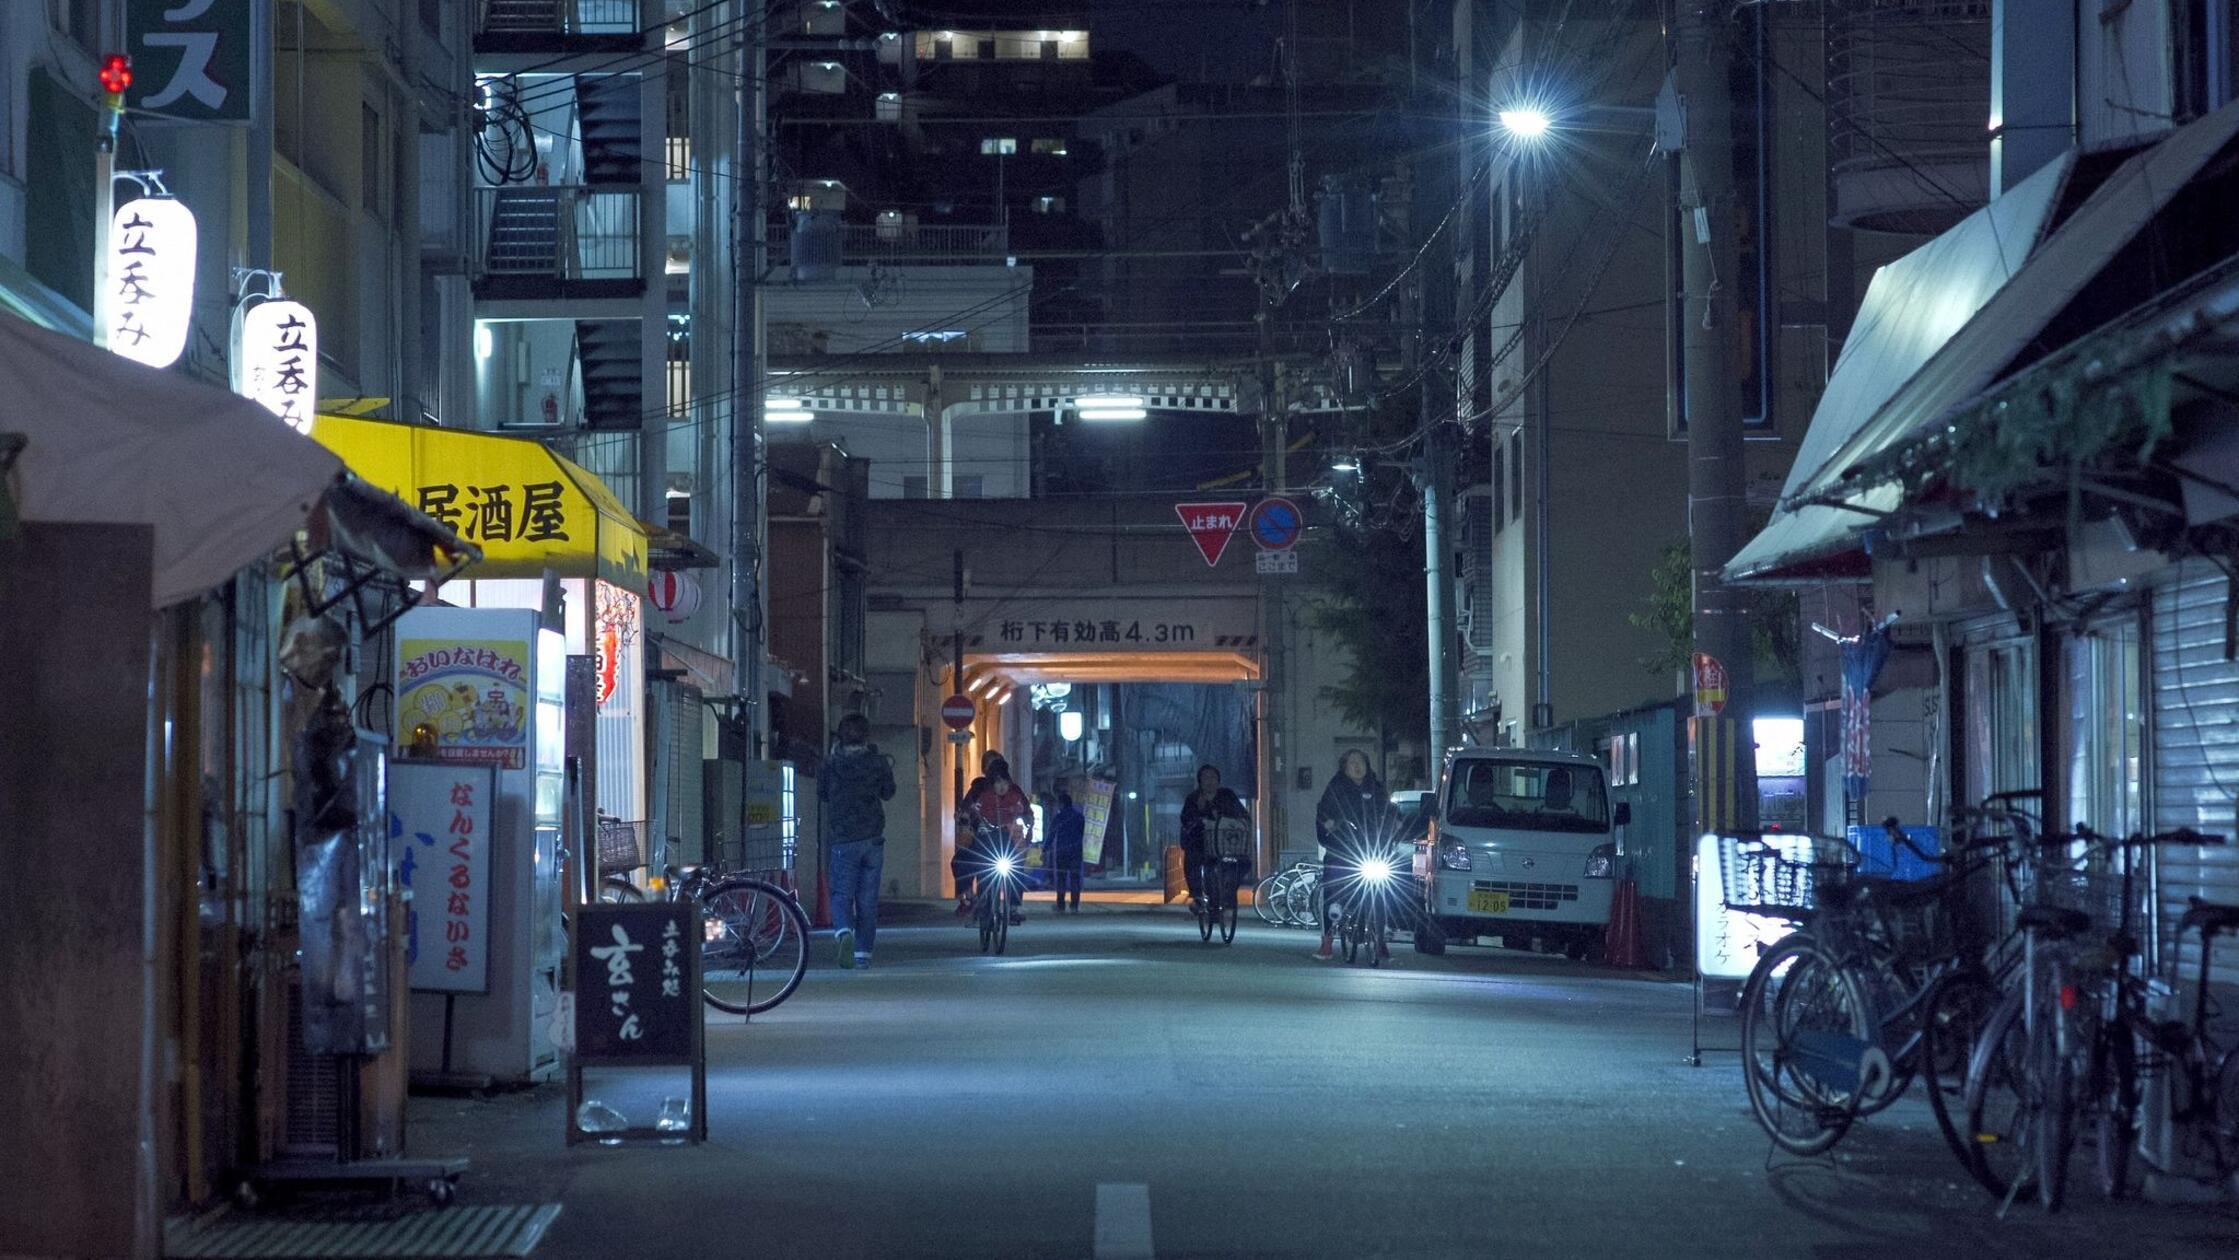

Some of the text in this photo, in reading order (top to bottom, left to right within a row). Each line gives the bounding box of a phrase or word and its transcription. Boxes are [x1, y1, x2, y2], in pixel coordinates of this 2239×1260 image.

[141, 0, 228, 110] ス
[116, 212, 157, 347] 立呑み
[272, 314, 309, 430] 立呑み
[417, 481, 570, 543] 居酒屋
[1190, 513, 1233, 530] 止まれ
[405, 646, 523, 680] おいなはれ
[1000, 619, 1195, 643] 桁下有効高4.3m
[445, 782, 474, 972] なんくるないさ
[589, 923, 644, 1040] 玄さん
[661, 919, 682, 997] 立呑み処
